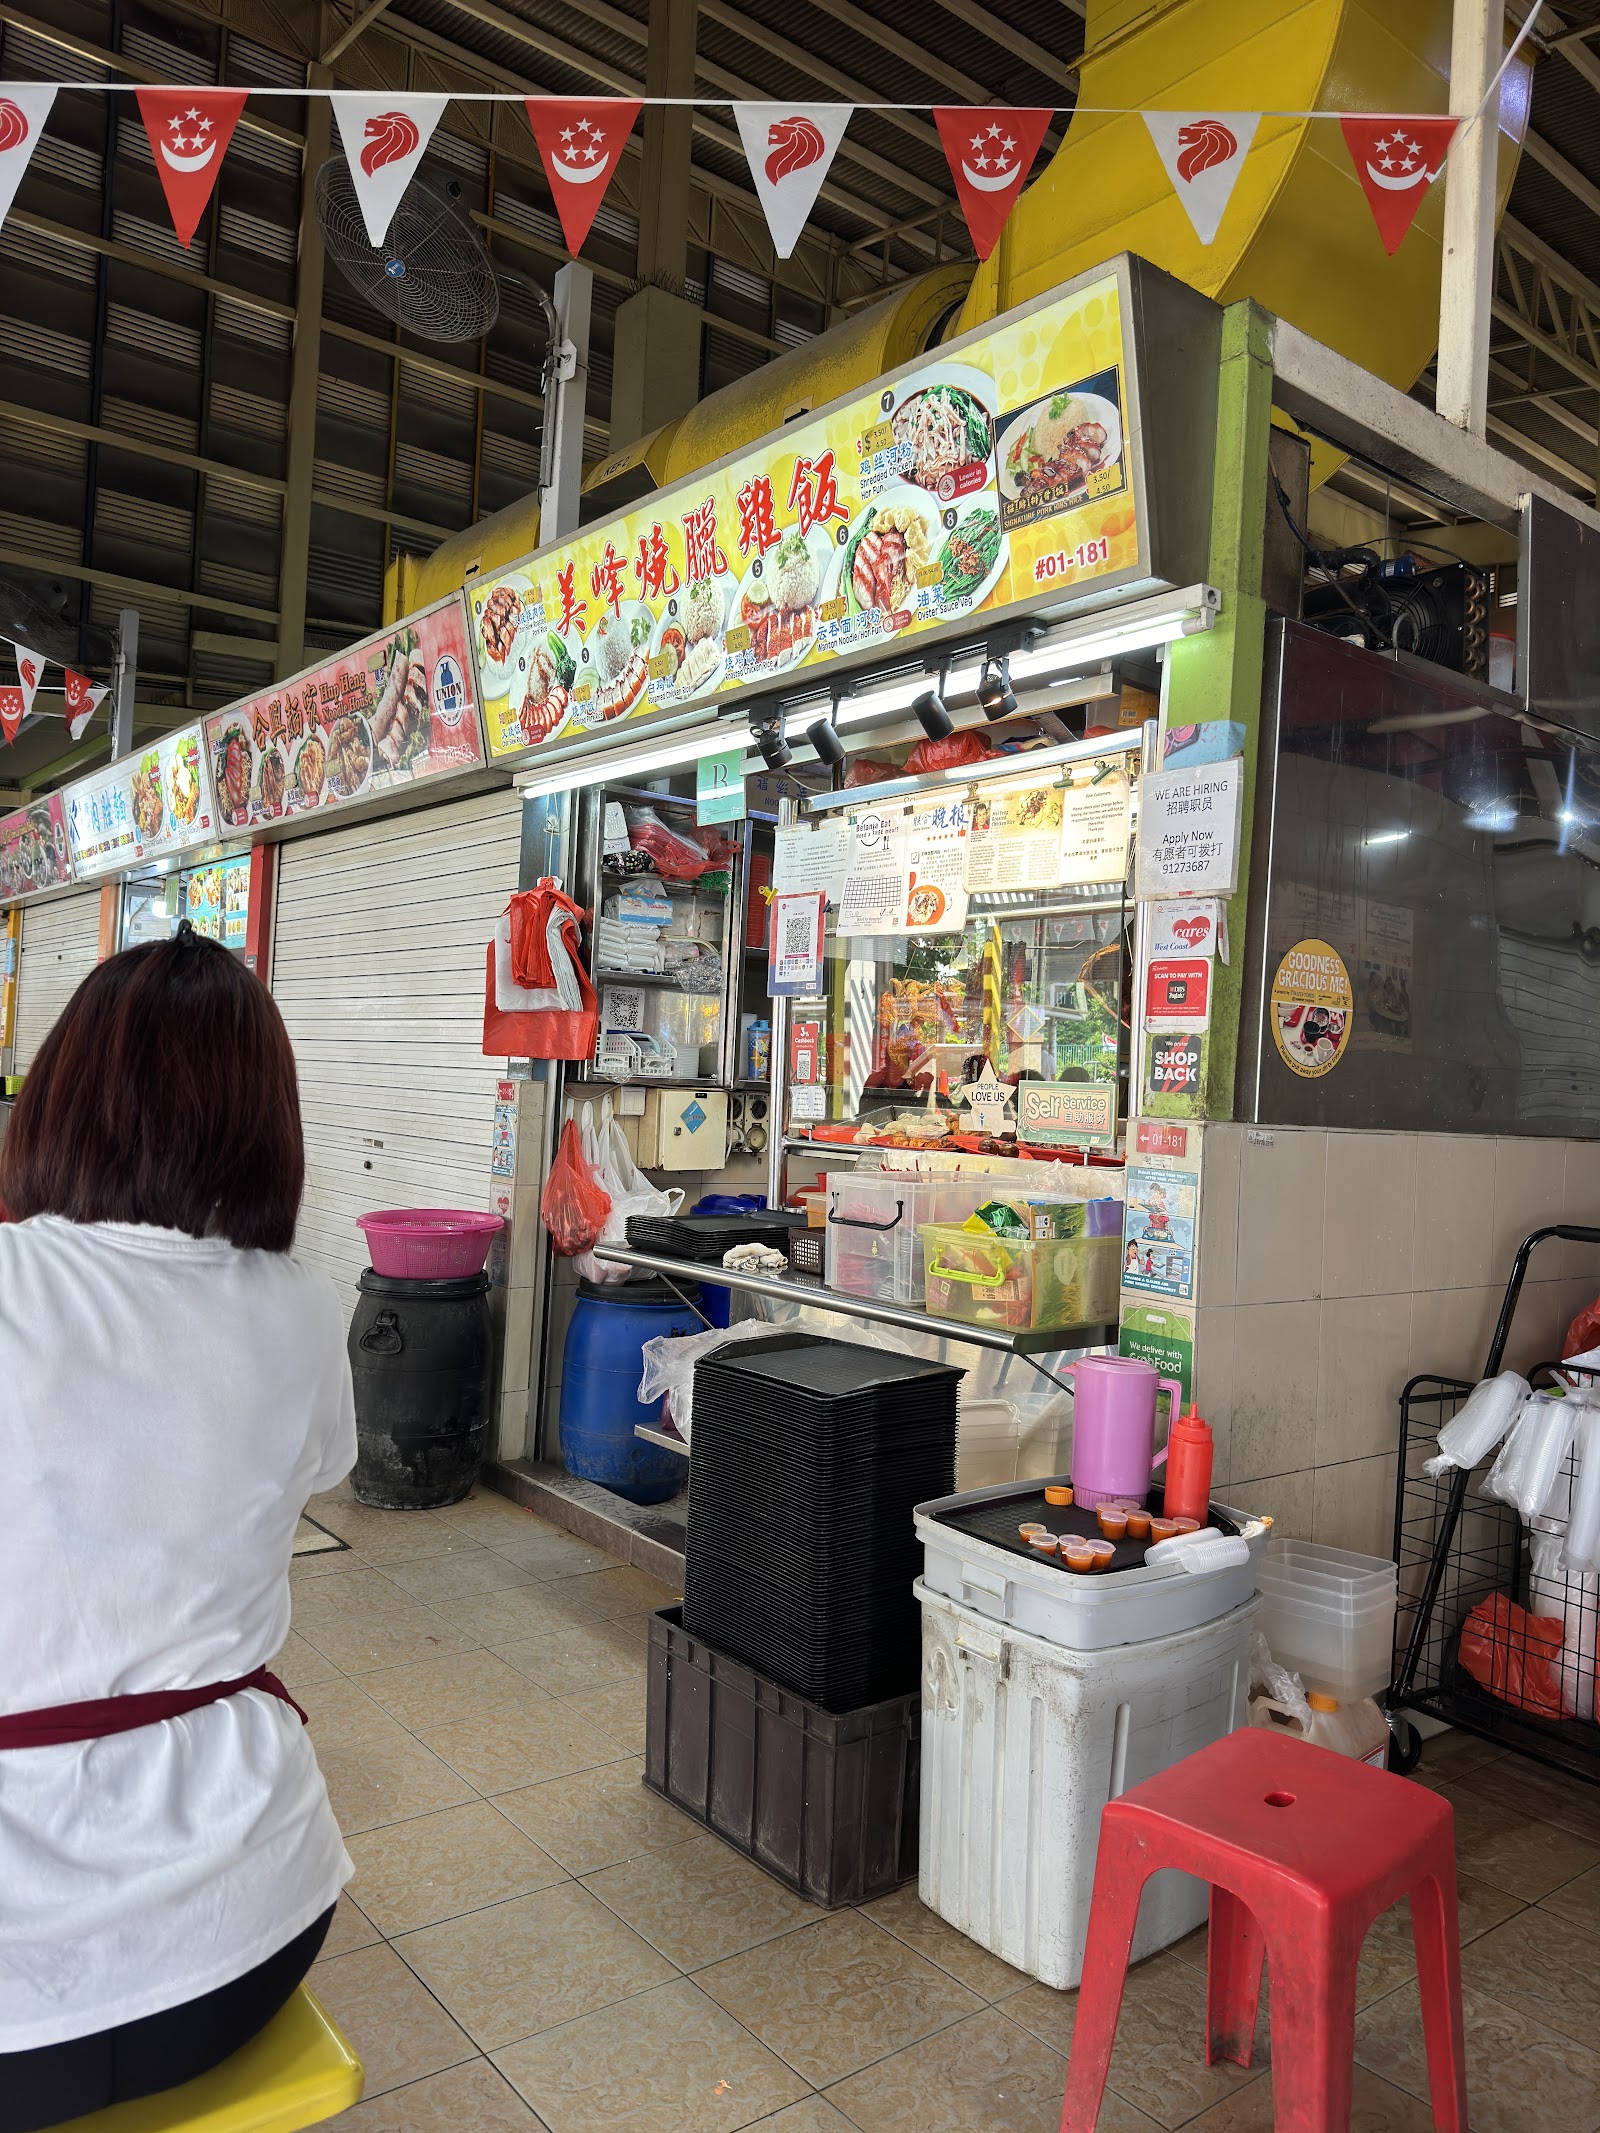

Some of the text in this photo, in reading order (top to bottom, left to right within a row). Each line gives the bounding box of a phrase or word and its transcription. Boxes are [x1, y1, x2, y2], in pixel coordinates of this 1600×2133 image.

[860, 441, 913, 474] 鸡丝河粉
[860, 460, 913, 489] Shredded Chicken
[861, 484, 884, 500] Hor Fun
[1004, 510, 1035, 528] SIGNATURE
[1036, 505, 1053, 517] PORK
[1054, 501, 1068, 511] RIBS
[1035, 538, 1108, 580] #01-181
[917, 585, 945, 608] 油菜
[917, 597, 972, 620] Oyster Sauce Veg
[817, 639, 838, 653] Wanton
[872, 626, 882, 636] Fun
[725, 648, 755, 671] 烧鸡饭
[319, 682, 340, 706] Hup
[340, 672, 366, 695] Heng
[436, 682, 462, 701] UNION
[648, 676, 674, 694] 白鸡饭
[322, 693, 373, 724] Noodle House
[1155, 781, 1228, 801] WE ARE HIRING
[1167, 797, 1213, 816] 招聘职员
[1163, 831, 1214, 846] Apply Now
[1153, 842, 1223, 862] 有愿者可拨打
[1163, 860, 1210, 874] 91273687
[1175, 927, 1209, 938] cares
[1154, 942, 1188, 951] West Coast
[1288, 951, 1340, 975] GOODNESS
[1278, 969, 1349, 995] GRACIOUS ME!
[1155, 1051, 1197, 1065] SHOP
[1280, 1045, 1292, 1064] Please
[1291, 1063, 1299, 1071] put
[1300, 1067, 1312, 1076] away
[1311, 1067, 1322, 1077] your
[1154, 1067, 1197, 1081] BACK
[972, 1092, 1005, 1101] LOVE US
[1027, 1092, 1106, 1119] Self Service
[1064, 1111, 1105, 1124] 自助服务
[1152, 1134, 1183, 1148] 01-181
[1130, 1341, 1182, 1360] We deliver with
